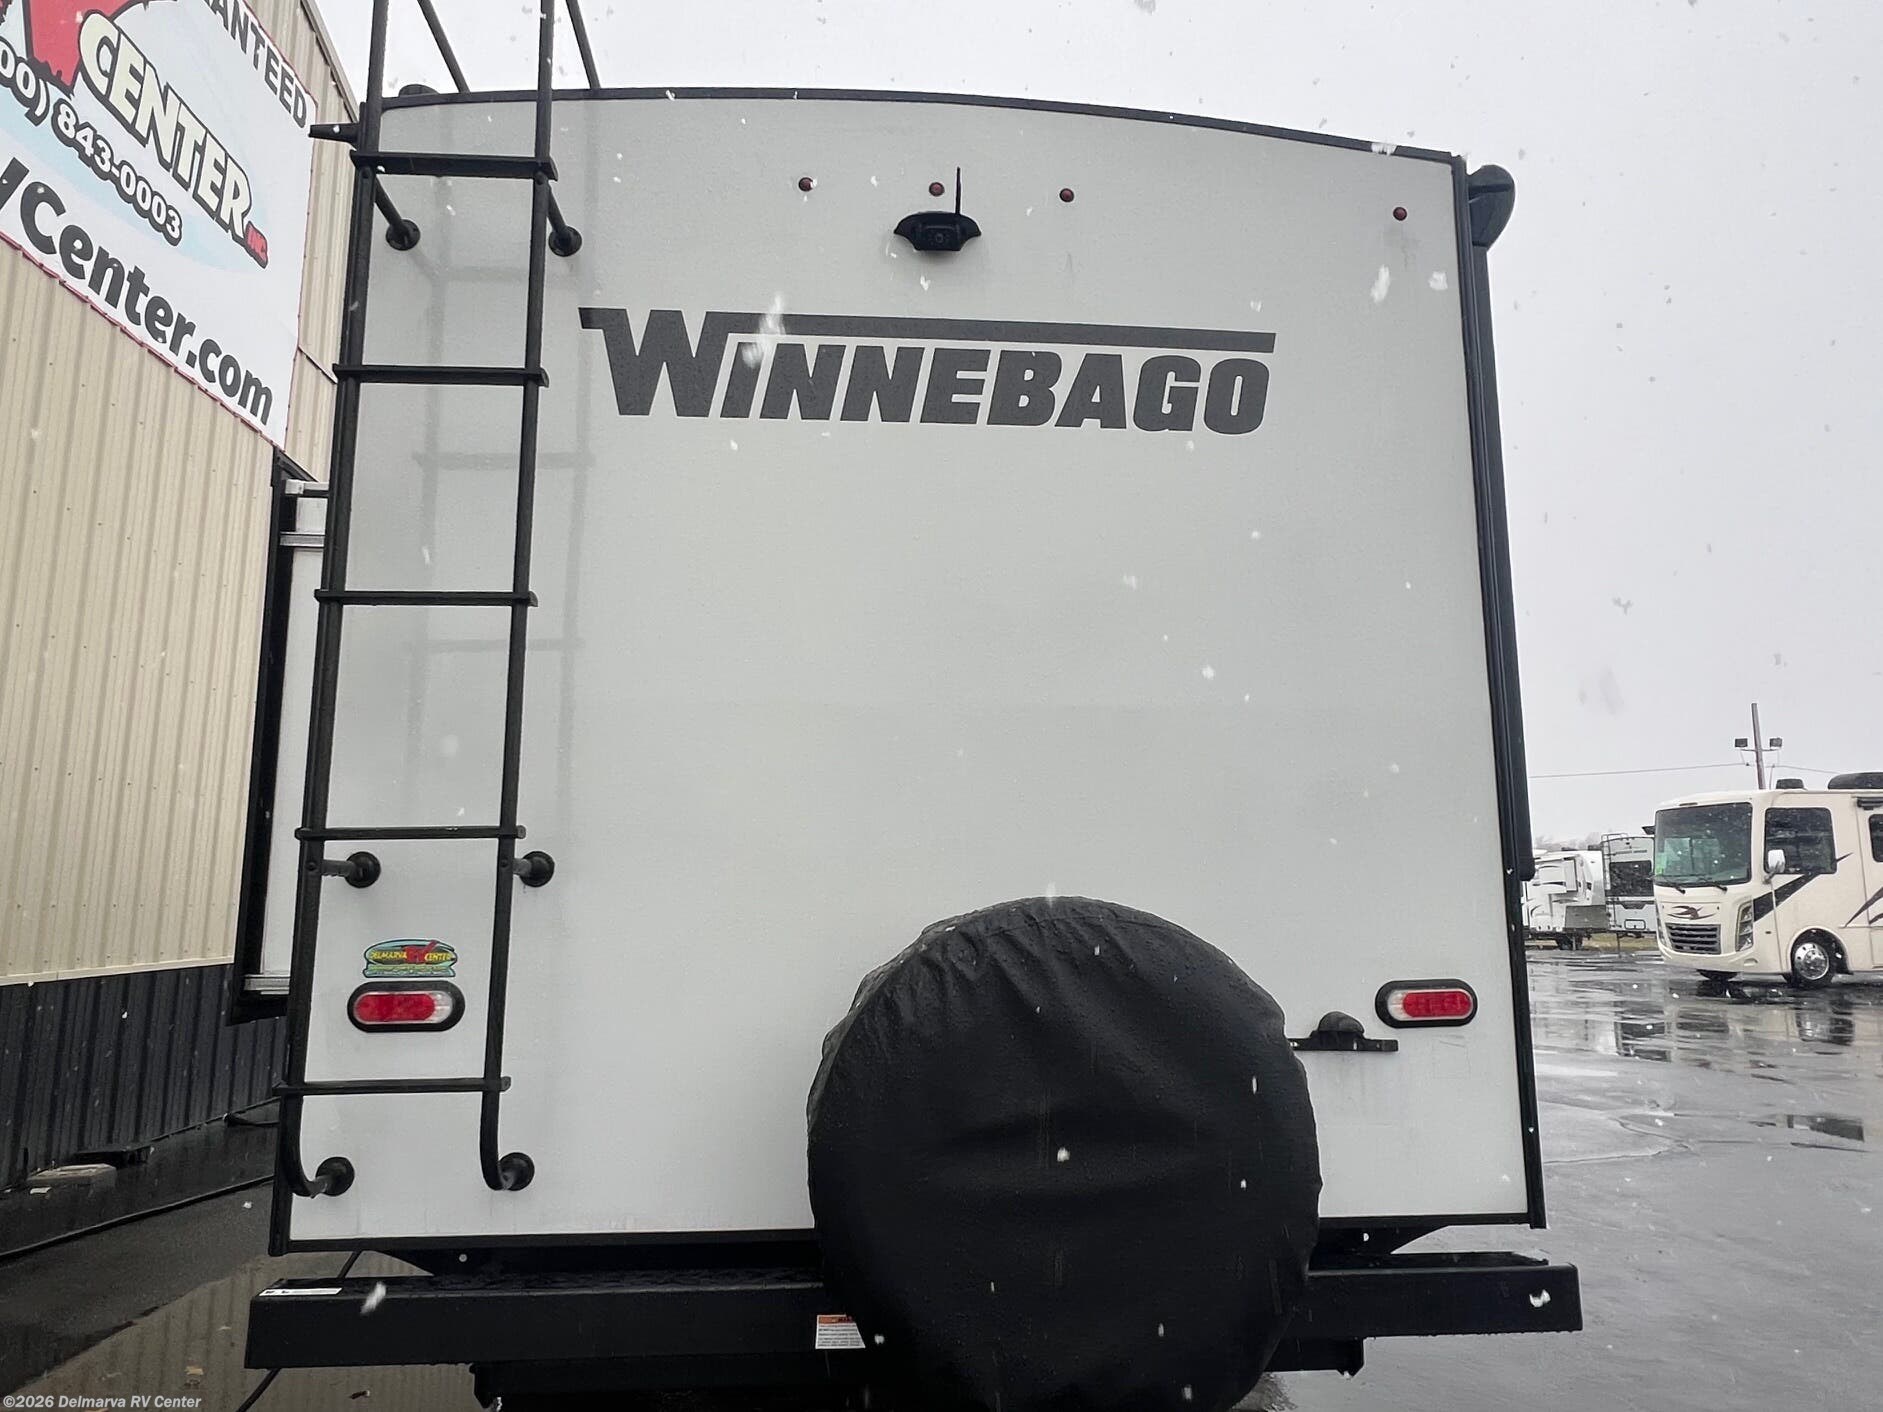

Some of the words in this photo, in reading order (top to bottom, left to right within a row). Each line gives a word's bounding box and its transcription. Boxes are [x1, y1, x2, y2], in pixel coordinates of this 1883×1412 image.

[79, 10, 252, 240] CENTER
[203, 0, 307, 128] ANTEED
[56, 102, 183, 241] 843-0003
[578, 306, 1276, 436] WINNEBAGO
